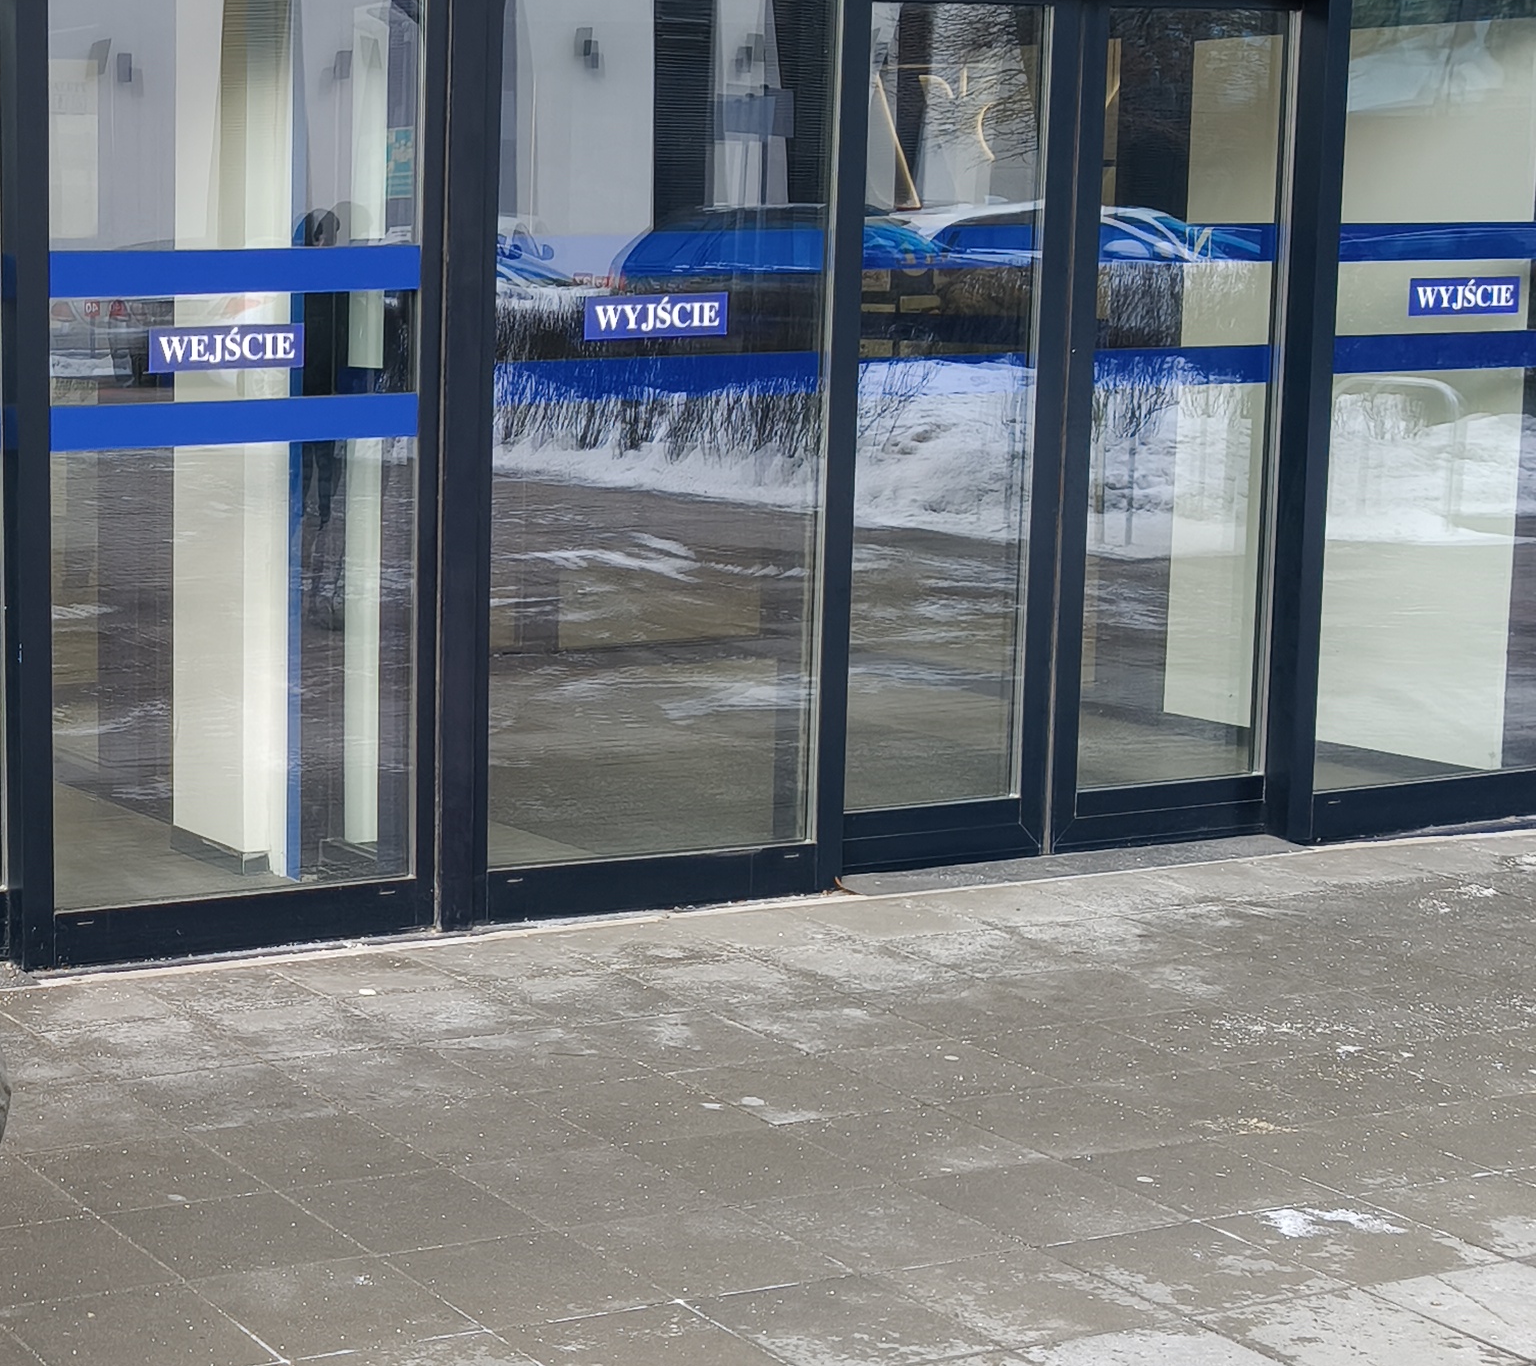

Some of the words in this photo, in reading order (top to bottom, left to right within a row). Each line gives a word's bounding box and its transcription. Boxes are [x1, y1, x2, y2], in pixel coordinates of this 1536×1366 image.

[1417, 278, 1513, 309] WYJŚCIE
[595, 295, 720, 331] WYJŚCIE
[159, 325, 295, 363] WEJŚCIE
